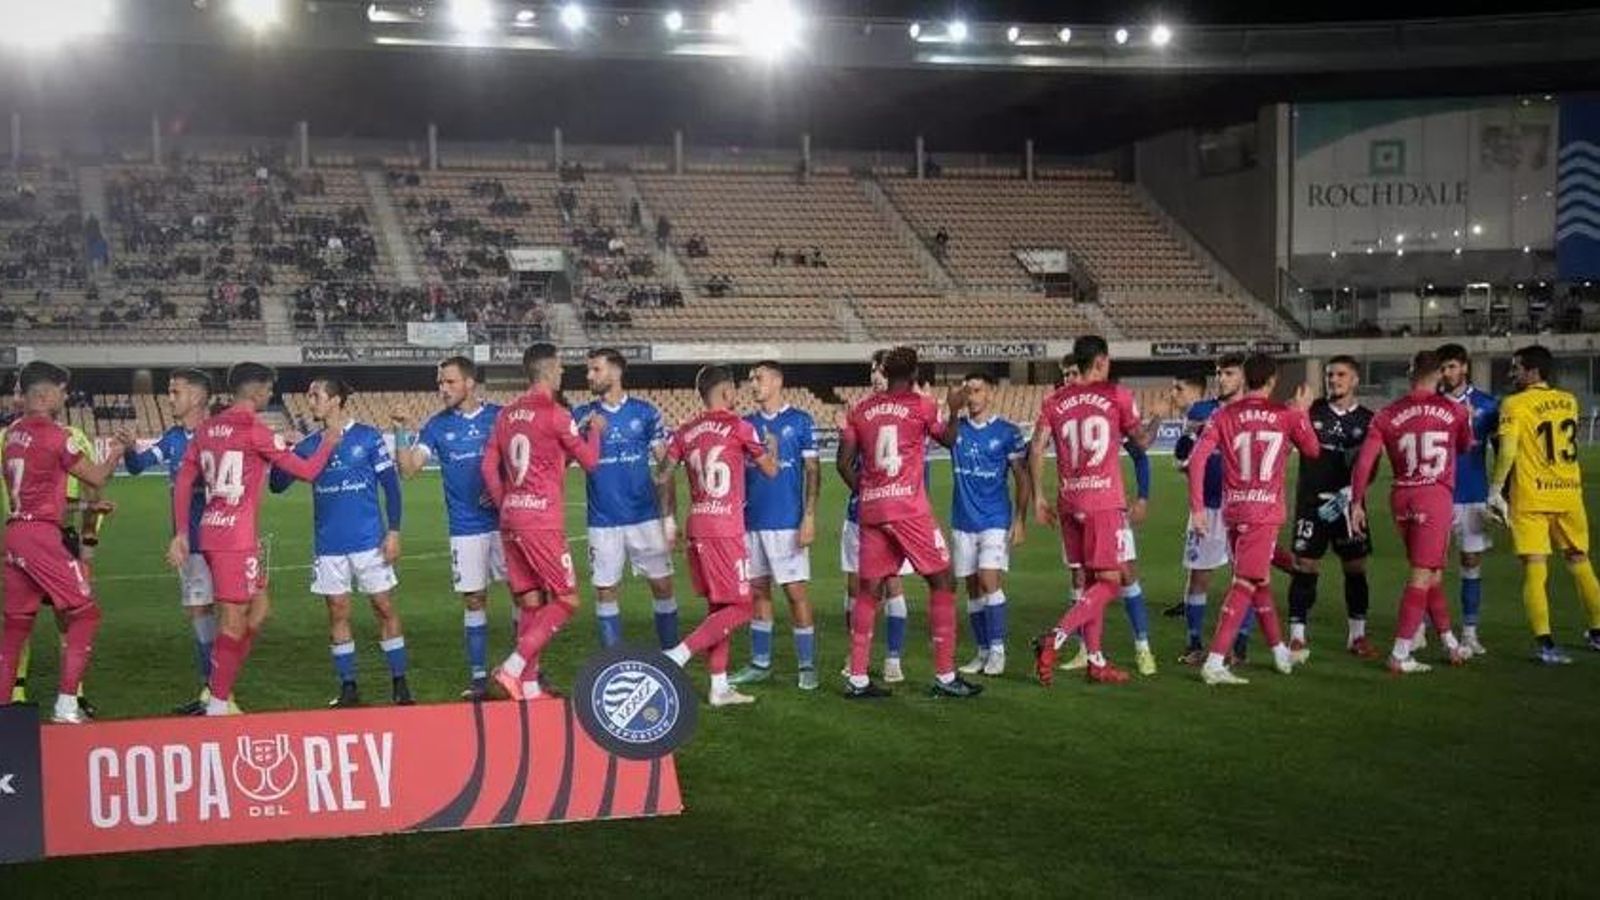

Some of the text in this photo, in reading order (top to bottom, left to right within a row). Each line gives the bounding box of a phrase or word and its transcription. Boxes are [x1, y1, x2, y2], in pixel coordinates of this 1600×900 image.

[510, 433, 530, 487] 9
[875, 424, 902, 477] 4
[1062, 415, 1110, 469] 19
[1233, 430, 1283, 481] 17
[1398, 431, 1449, 478] 15
[1537, 419, 1577, 465] 13
[689, 445, 731, 498] 16
[1297, 518, 1314, 539] 13
[560, 553, 572, 576] 9
[89, 731, 393, 828] COPA DEL REY
